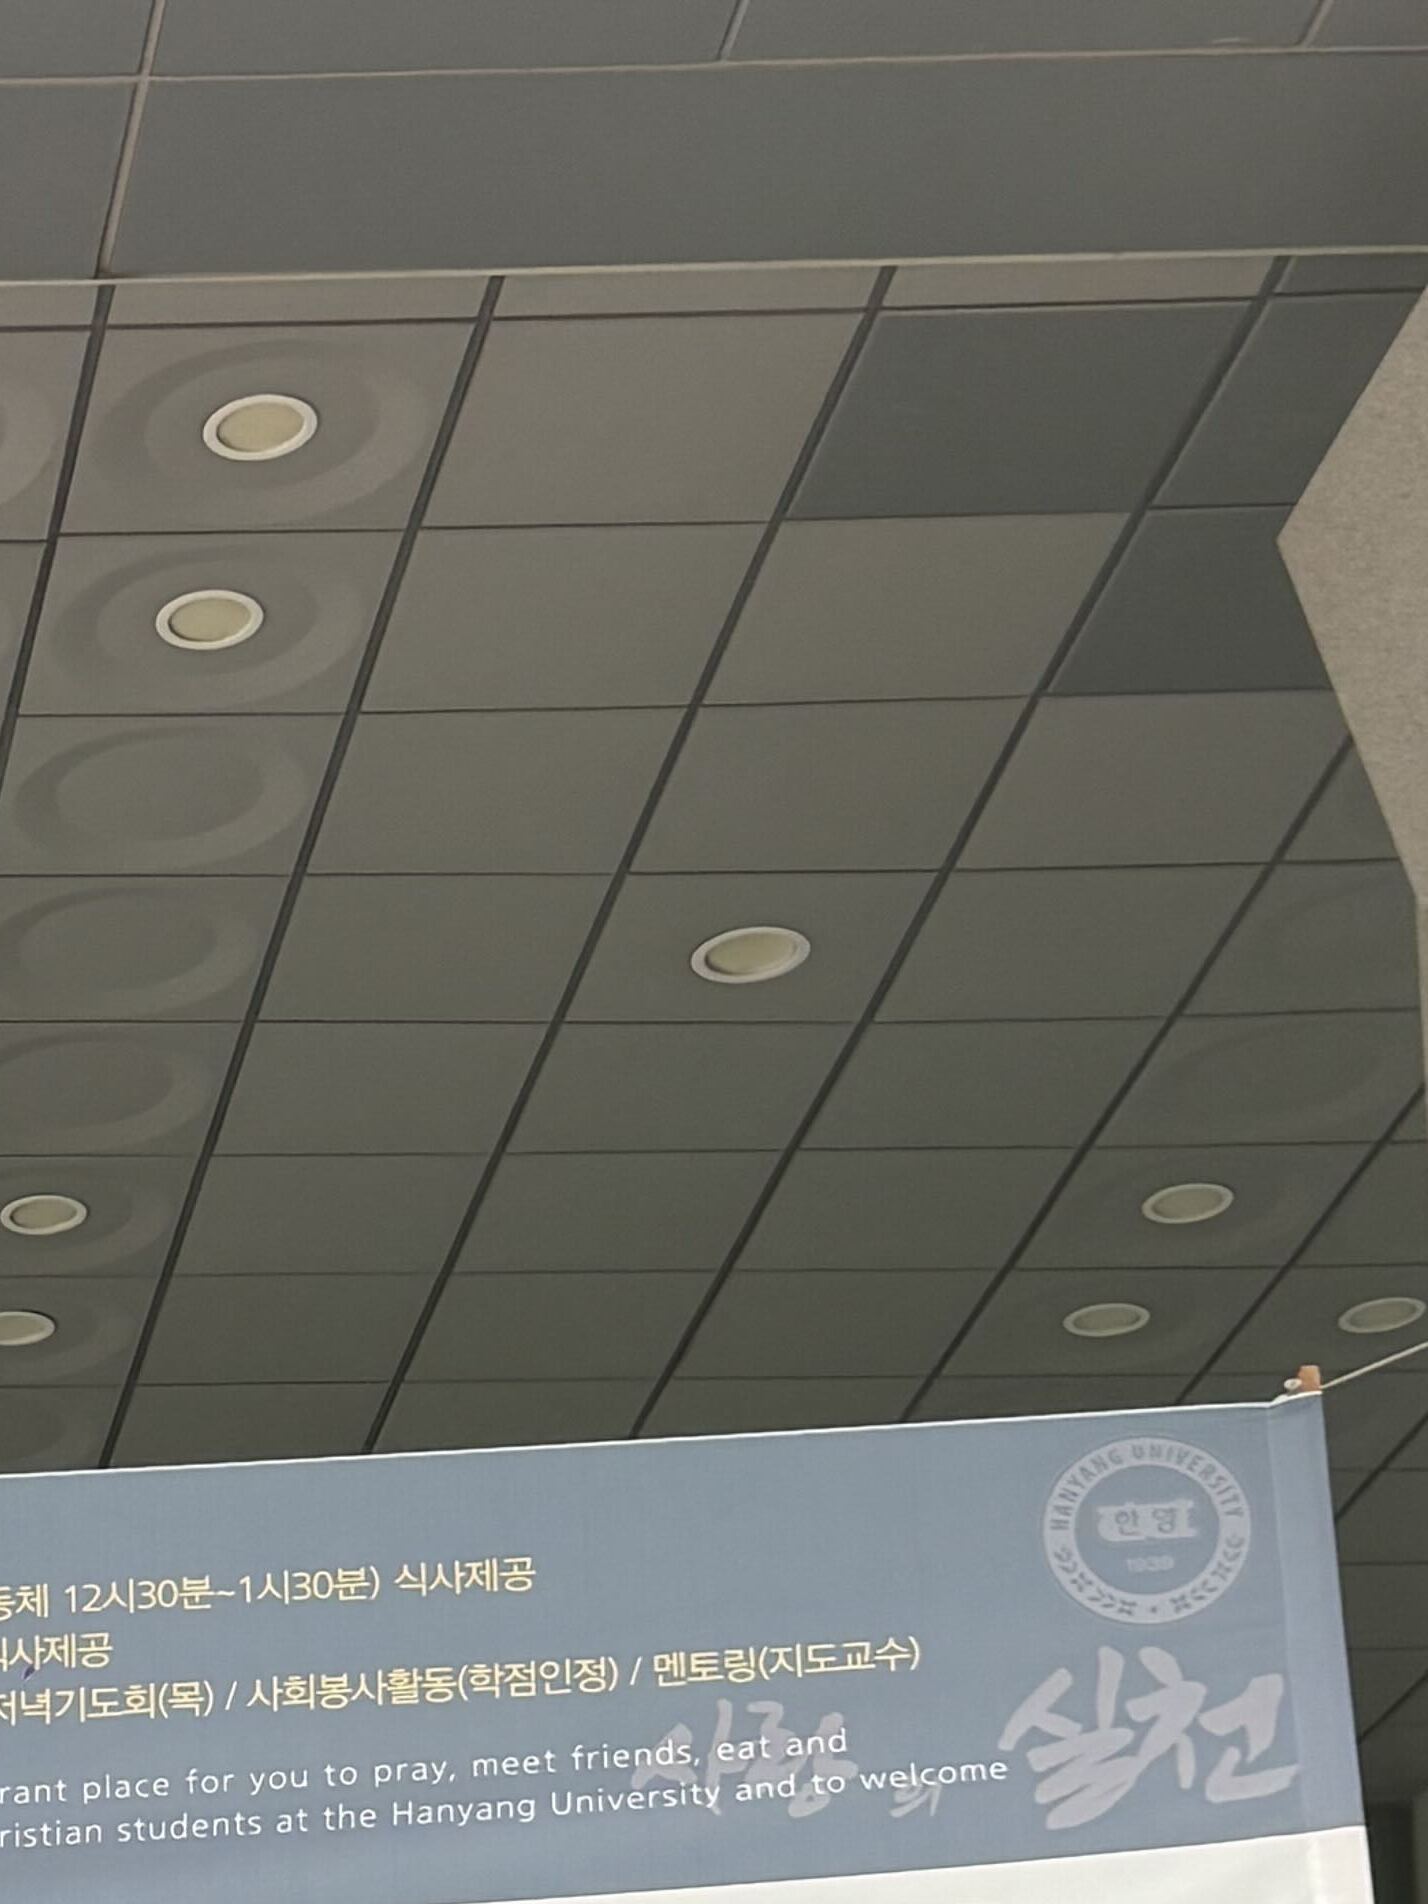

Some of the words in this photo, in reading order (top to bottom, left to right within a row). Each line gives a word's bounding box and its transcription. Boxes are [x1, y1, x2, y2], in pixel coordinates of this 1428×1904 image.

[1050, 1448, 1123, 1531] HANYANG
[1131, 1441, 1244, 1519] UNIVERSITY
[393, 1556, 537, 1597] 식사제공
[246, 1655, 619, 1713] 사회봉사활동(학점인정)
[653, 1635, 921, 1688] 멘토링(지도교수)
[83, 1773, 170, 1805] place
[185, 1767, 235, 1795] for
[249, 1769, 308, 1796] you
[323, 1763, 358, 1787] to
[374, 1760, 456, 1788] pray,
[472, 1749, 557, 1777] meet
[570, 1735, 700, 1771] friends,
[716, 1734, 772, 1761] eat
[785, 1727, 848, 1757] and
[117, 1811, 262, 1843] students
[276, 1808, 309, 1834] at
[323, 1802, 377, 1831] the
[392, 1799, 536, 1827] Hanyang
[551, 1771, 721, 1816] University
[734, 1773, 797, 1802] and
[811, 1773, 846, 1795] to
[859, 1761, 1009, 1791] welcome
